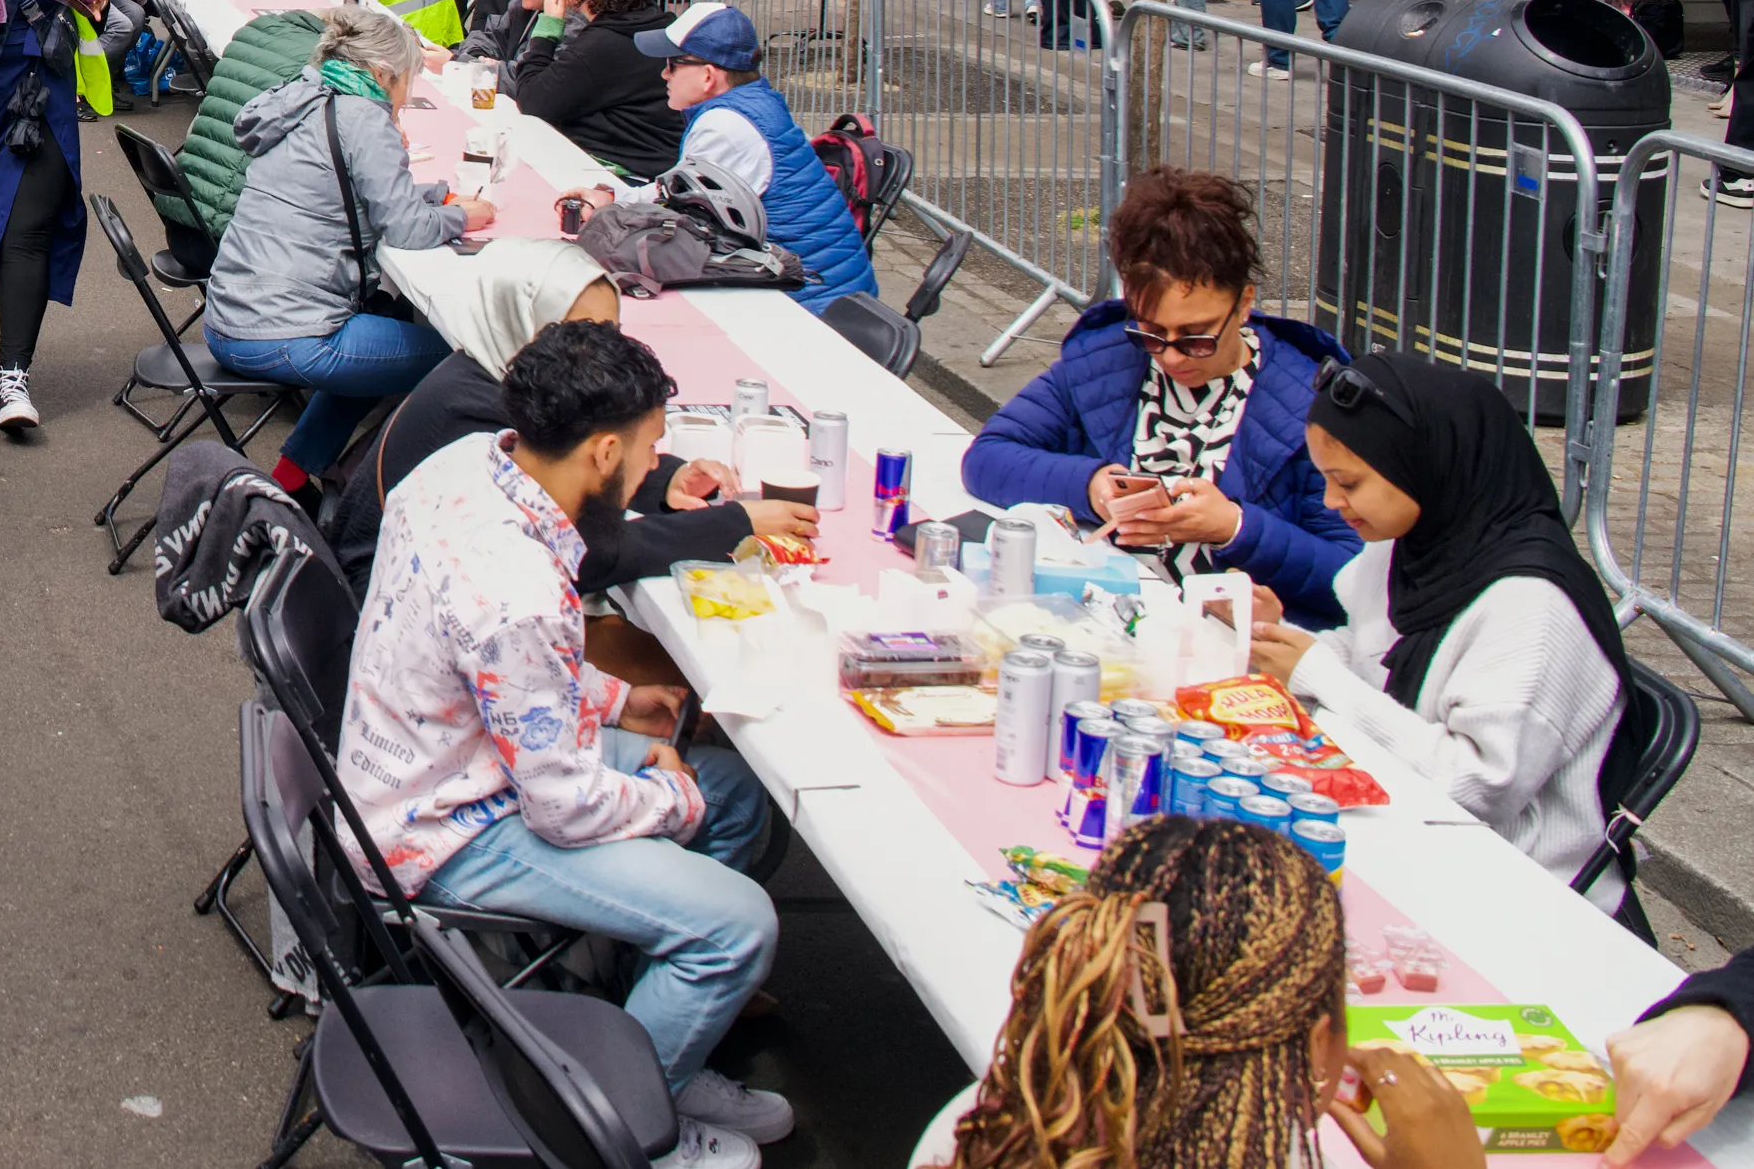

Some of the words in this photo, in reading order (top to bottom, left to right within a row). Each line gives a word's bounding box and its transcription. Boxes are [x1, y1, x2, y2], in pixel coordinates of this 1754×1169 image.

[897, 484, 909, 497] Bu
[1222, 689, 1273, 709] HULA
[359, 720, 417, 766] Limited
[349, 748, 402, 790] Edition
[1409, 1024, 1508, 1048] Kipling
[1438, 1057, 1477, 1065] BRAMLEY
[1478, 1057, 1500, 1065] APPLE
[1501, 1057, 1524, 1066] PIES
[1498, 1139, 1526, 1147] APPLE
[1527, 1139, 1548, 1147] PIES
[1507, 1131, 1551, 1140] BRAMLEY
